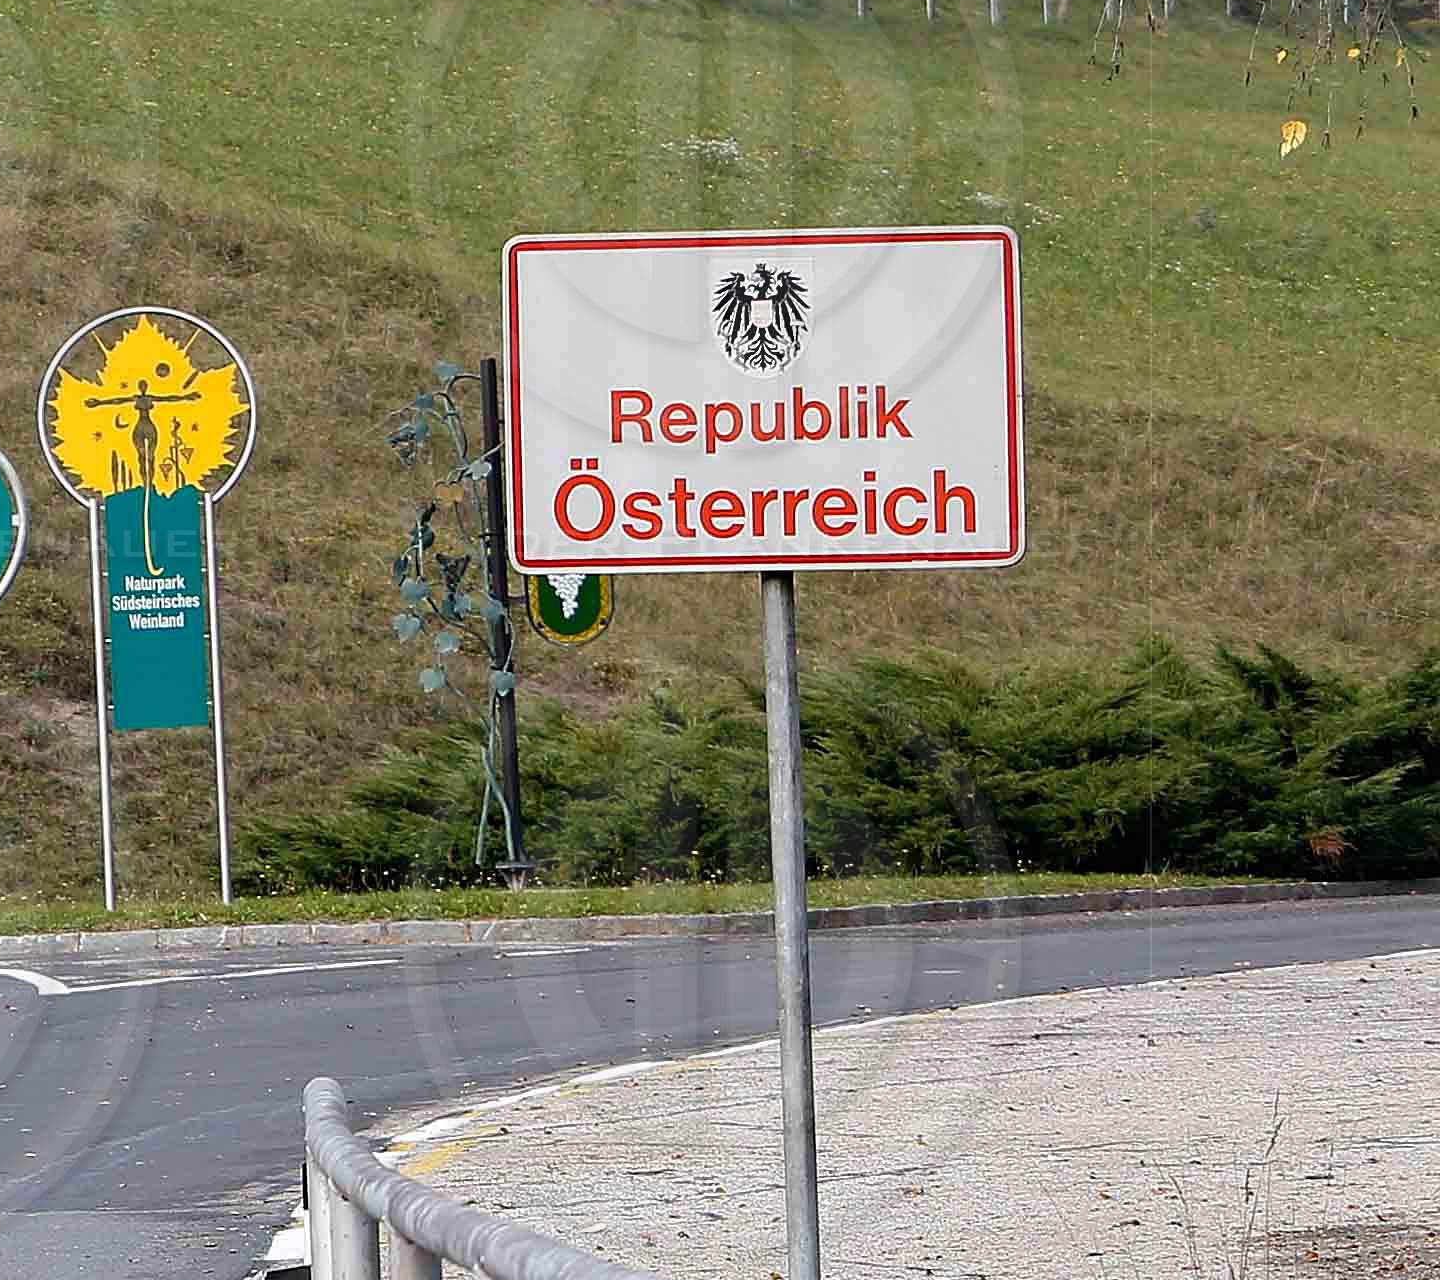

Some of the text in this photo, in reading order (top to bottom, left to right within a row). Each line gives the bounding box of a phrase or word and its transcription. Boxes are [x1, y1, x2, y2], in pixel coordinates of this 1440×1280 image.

[610, 385, 913, 455] Republik
[553, 457, 977, 542] Österreich
[124, 573, 186, 593] Naturpark
[111, 593, 201, 612] Südsteirisches
[128, 611, 185, 630] Weinland
